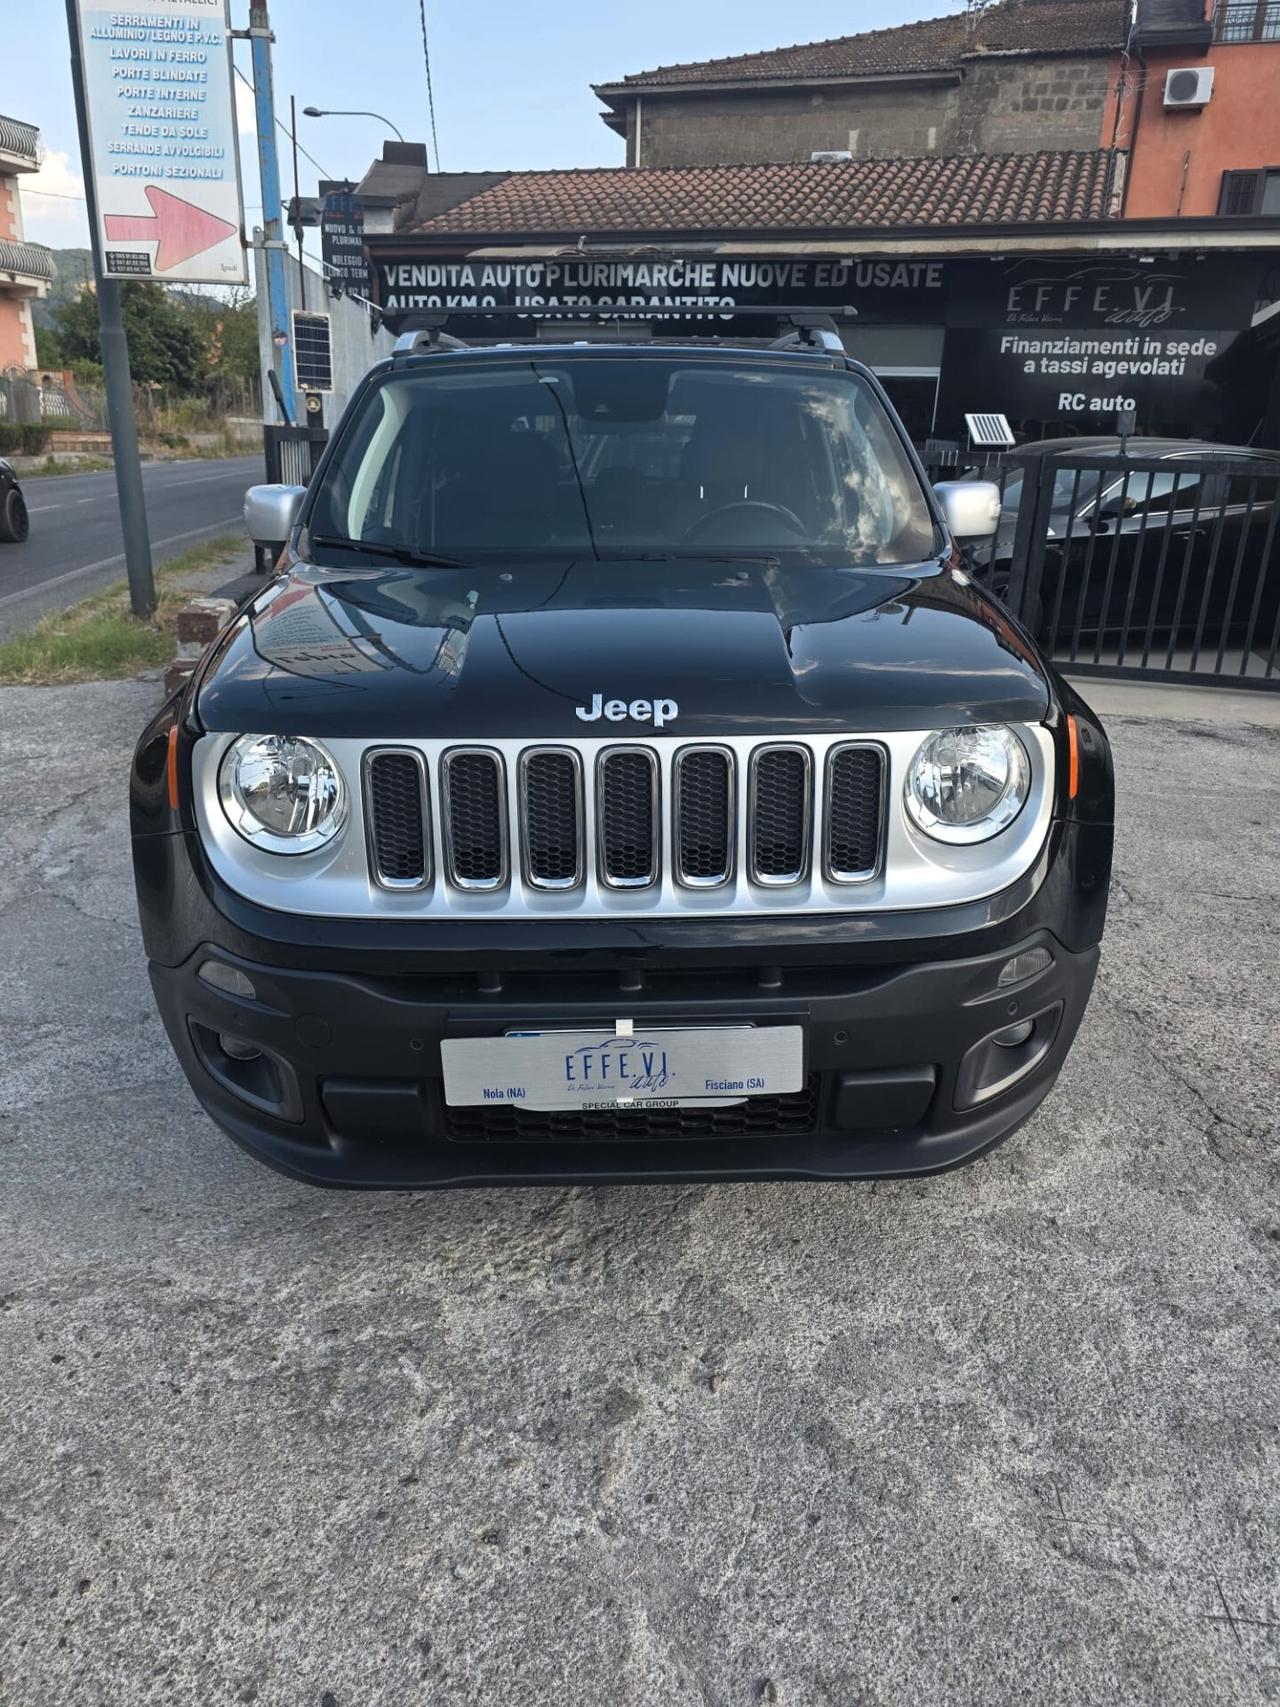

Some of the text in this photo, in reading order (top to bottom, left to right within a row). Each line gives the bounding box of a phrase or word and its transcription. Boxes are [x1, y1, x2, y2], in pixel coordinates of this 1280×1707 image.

[111, 14, 200, 30] SERRAMENTI IN
[187, 31, 193, 42] E
[109, 47, 207, 64] LAVORI IN FERRO
[112, 67, 207, 83] PORTE BLINDATE
[117, 87, 206, 101] PORTE INTERNE
[128, 105, 199, 120] ZANZARIERE
[121, 124, 208, 139] TENDE DA SOLE
[107, 143, 224, 159] SERRANDE AVVOLGIBILI
[112, 163, 224, 180] PORTONI SEZIONALI
[384, 263, 944, 288] VENDITA AUTO PLURIMARCHE NUOVE ED USATE
[1000, 336, 1217, 356] Finanziamenti in sede
[1023, 357, 1186, 379] a tassi agevolati
[1058, 392, 1136, 412] RC auto
[575, 693, 679, 728] Jeep
[705, 1077, 765, 1090] Fisciano (SA)
[483, 1087, 526, 1099] Nola (NA)
[582, 1100, 680, 1110] SPECIAL CAR GROUP
